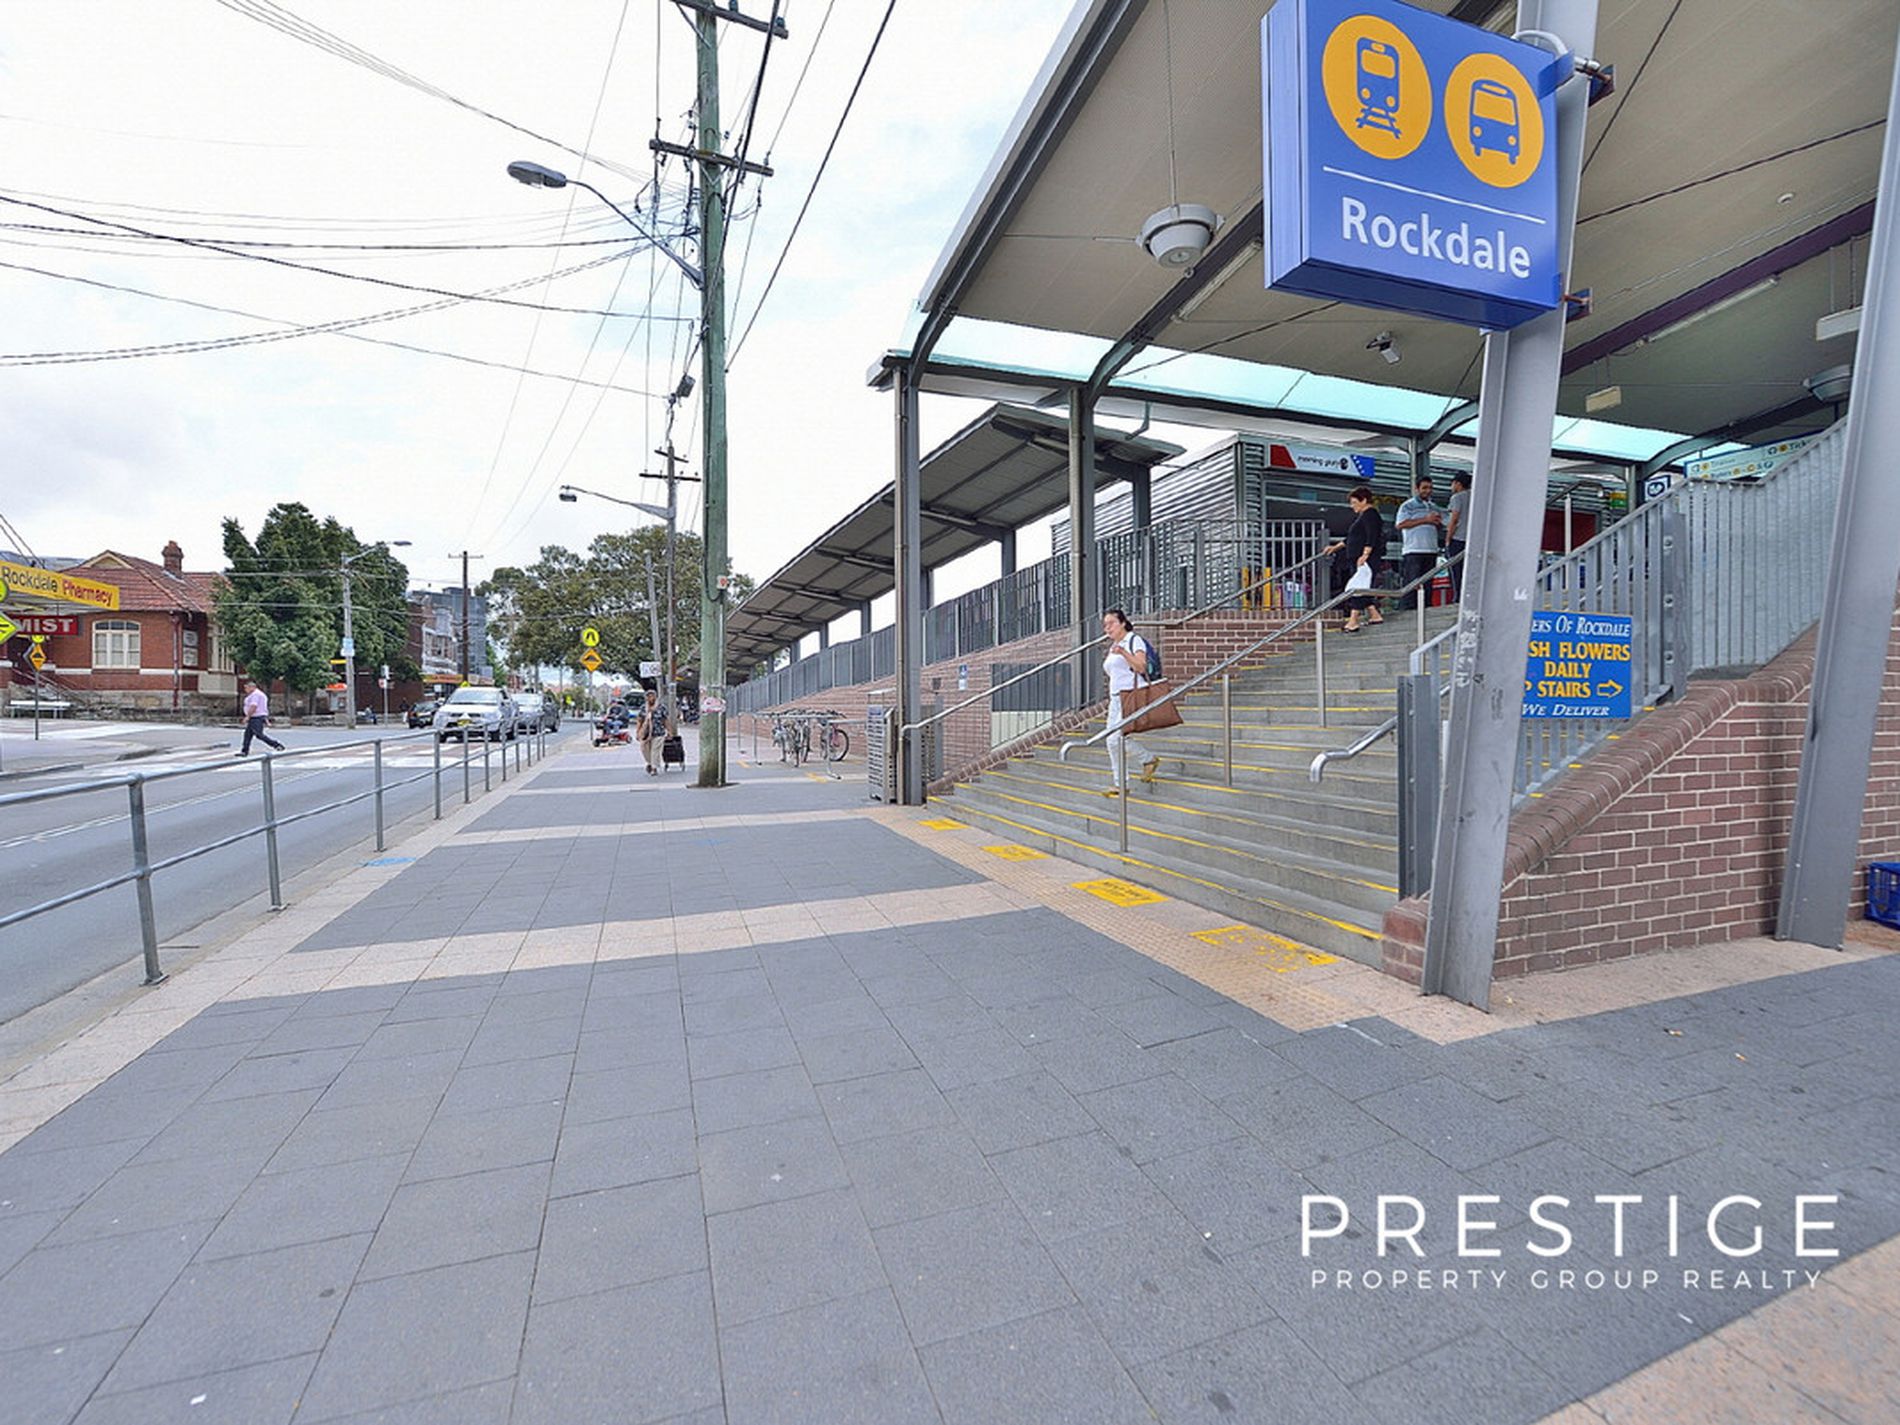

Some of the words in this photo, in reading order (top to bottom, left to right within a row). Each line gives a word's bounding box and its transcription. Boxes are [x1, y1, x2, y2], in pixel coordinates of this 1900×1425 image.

[1341, 196, 1531, 279] Rockdale
[2, 565, 58, 593] Rockdale
[62, 578, 113, 607] Pharmacy
[1528, 640, 1551, 658] SH
[1559, 641, 1631, 661] FLOWERS
[1544, 660, 1592, 679] DAILY
[1537, 681, 1591, 698] STAIRS
